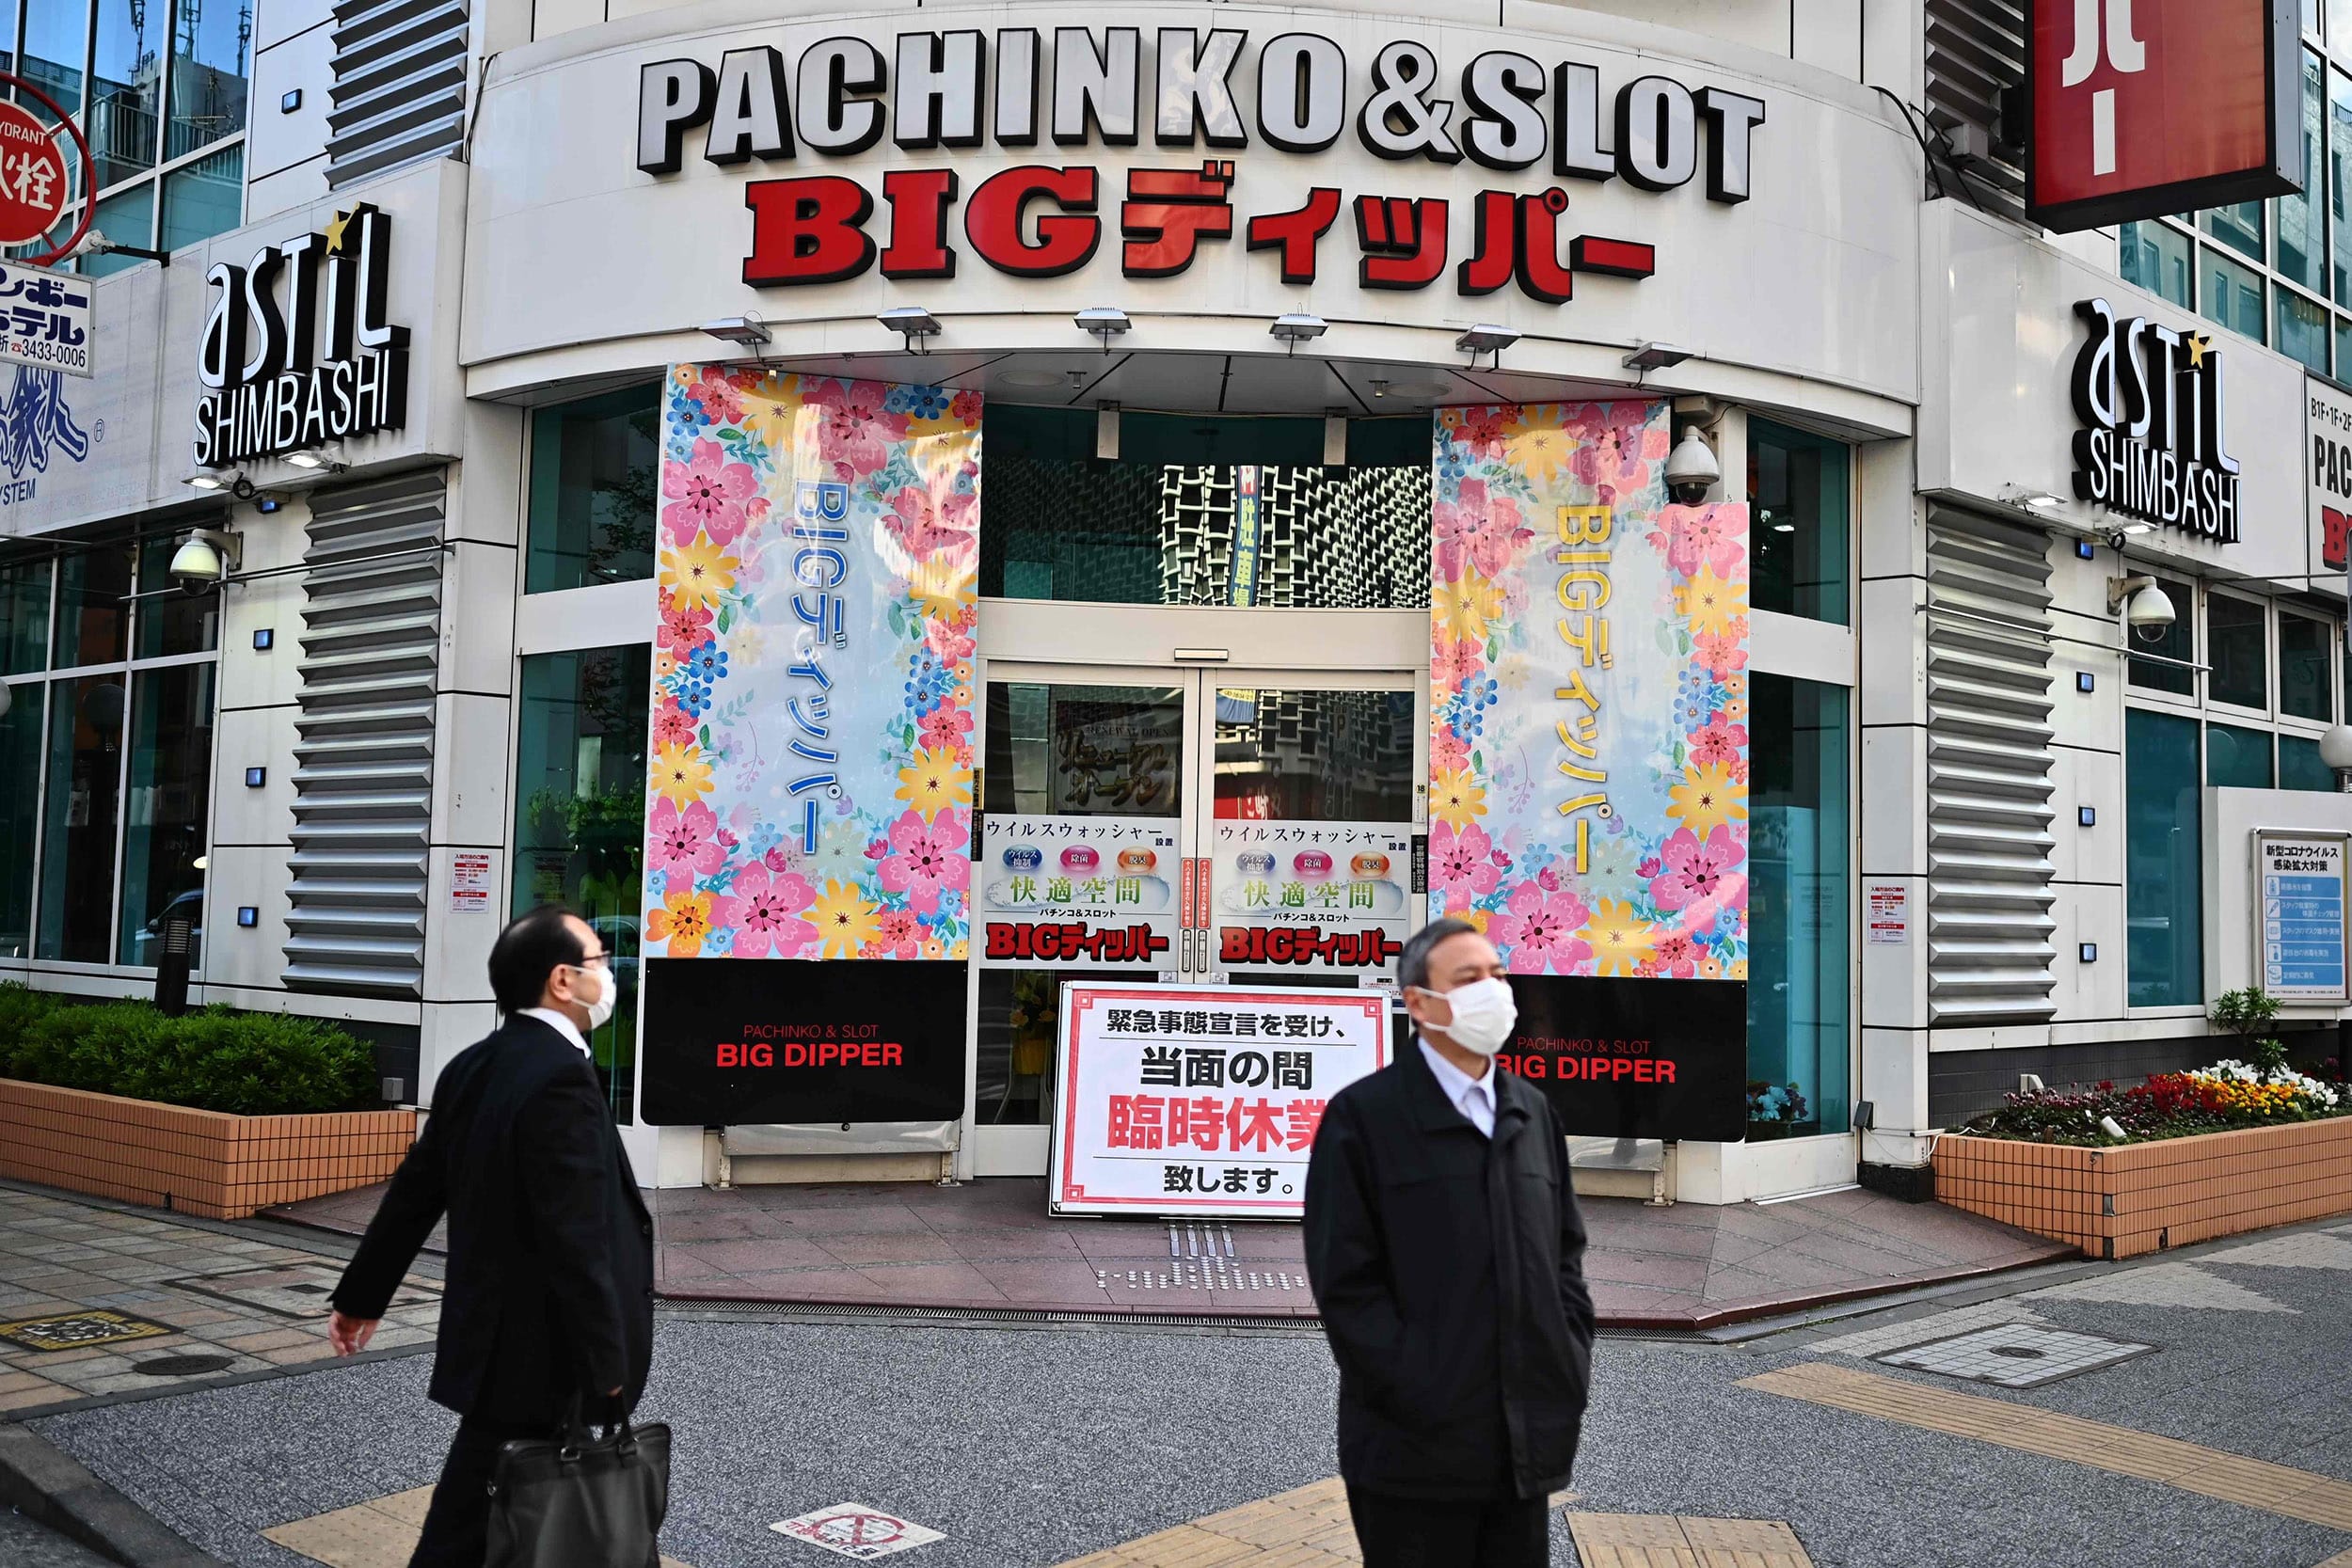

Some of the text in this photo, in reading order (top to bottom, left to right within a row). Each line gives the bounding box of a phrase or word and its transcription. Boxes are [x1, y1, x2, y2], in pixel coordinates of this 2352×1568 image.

[636, 26, 1766, 204] PACHINKO&SLOT
[741, 160, 1656, 305] BIGディッパー
[22, 339, 86, 367] 3433-0006
[193, 349, 408, 467] SHIMBASHI
[2072, 428, 2240, 544] SHIMBASHI
[2322, 504, 2352, 572] B
[787, 480, 850, 855] BIGディッパー
[1553, 505, 1613, 873] BIGディッパー
[987, 820, 1163, 840] ウイルスウォッシャー
[1220, 825, 1396, 845] ウイルスウォッシャー
[1009, 849, 1038, 859] ウイルス
[1241, 855, 1270, 863] ウイルス
[2266, 845, 2339, 858] 新型コロナウイルス
[2273, 859, 2328, 872] 感染拡大対策
[1010, 876, 1141, 904] 快適空間
[1244, 879, 1375, 909] 快適空間
[985, 922, 1169, 963] BIGディッパー
[1219, 926, 1403, 967] BIGディッパー
[743, 1024, 880, 1039] PACHINKO & SLOT
[1107, 1009, 1345, 1038] 緊急事態宣言を受け、
[716, 1043, 903, 1068] BIG DIPPER
[1517, 1037, 1650, 1054] PACHINKO & SLOT
[1140, 1046, 1312, 1090] 当面の間
[1557, 1055, 1676, 1085] DIPPER
[1164, 1164, 1294, 1196] 致します。
